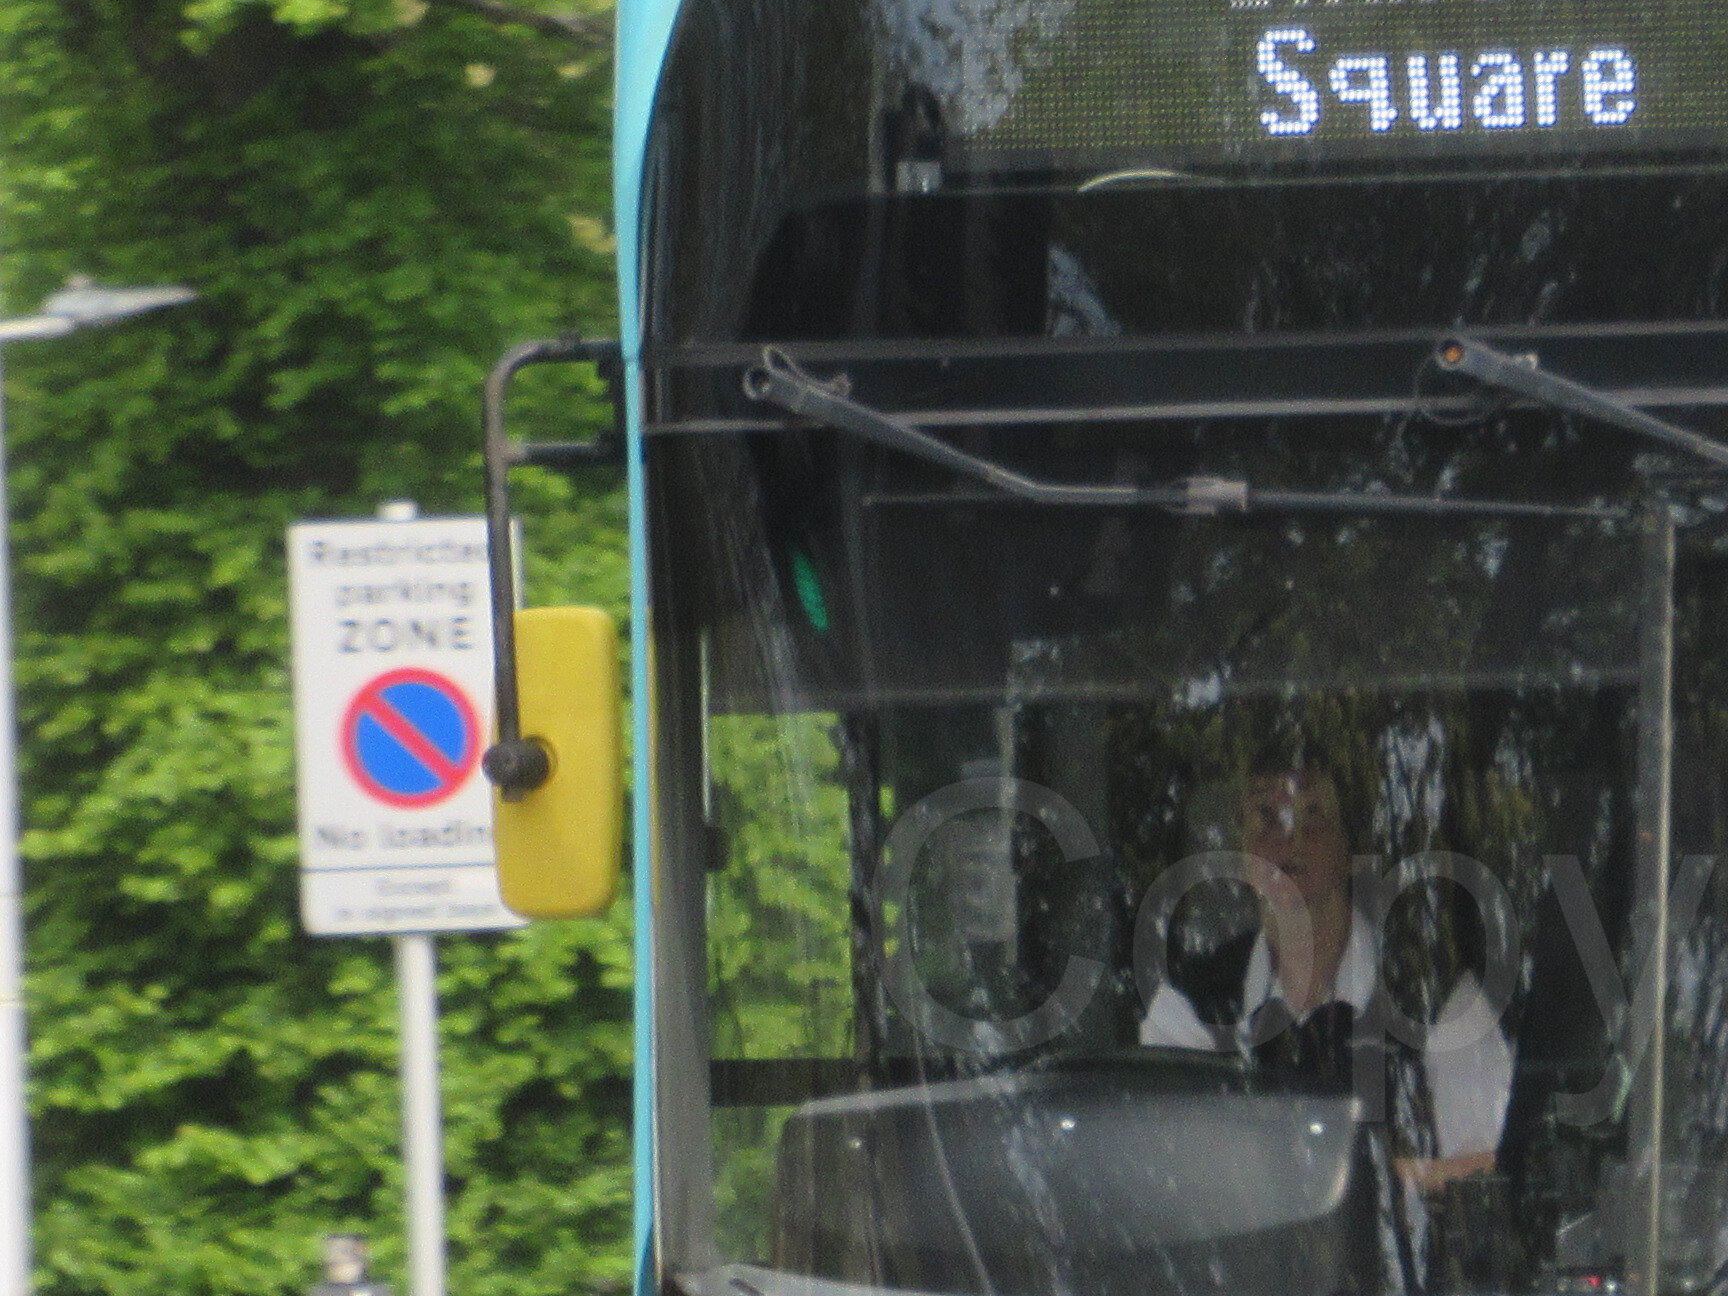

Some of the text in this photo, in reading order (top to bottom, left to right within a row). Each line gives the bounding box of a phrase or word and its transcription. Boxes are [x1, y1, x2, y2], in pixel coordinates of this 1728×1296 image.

[1257, 28, 1637, 136] Square
[338, 616, 472, 653] ZONE
[376, 821, 494, 849] loadin
